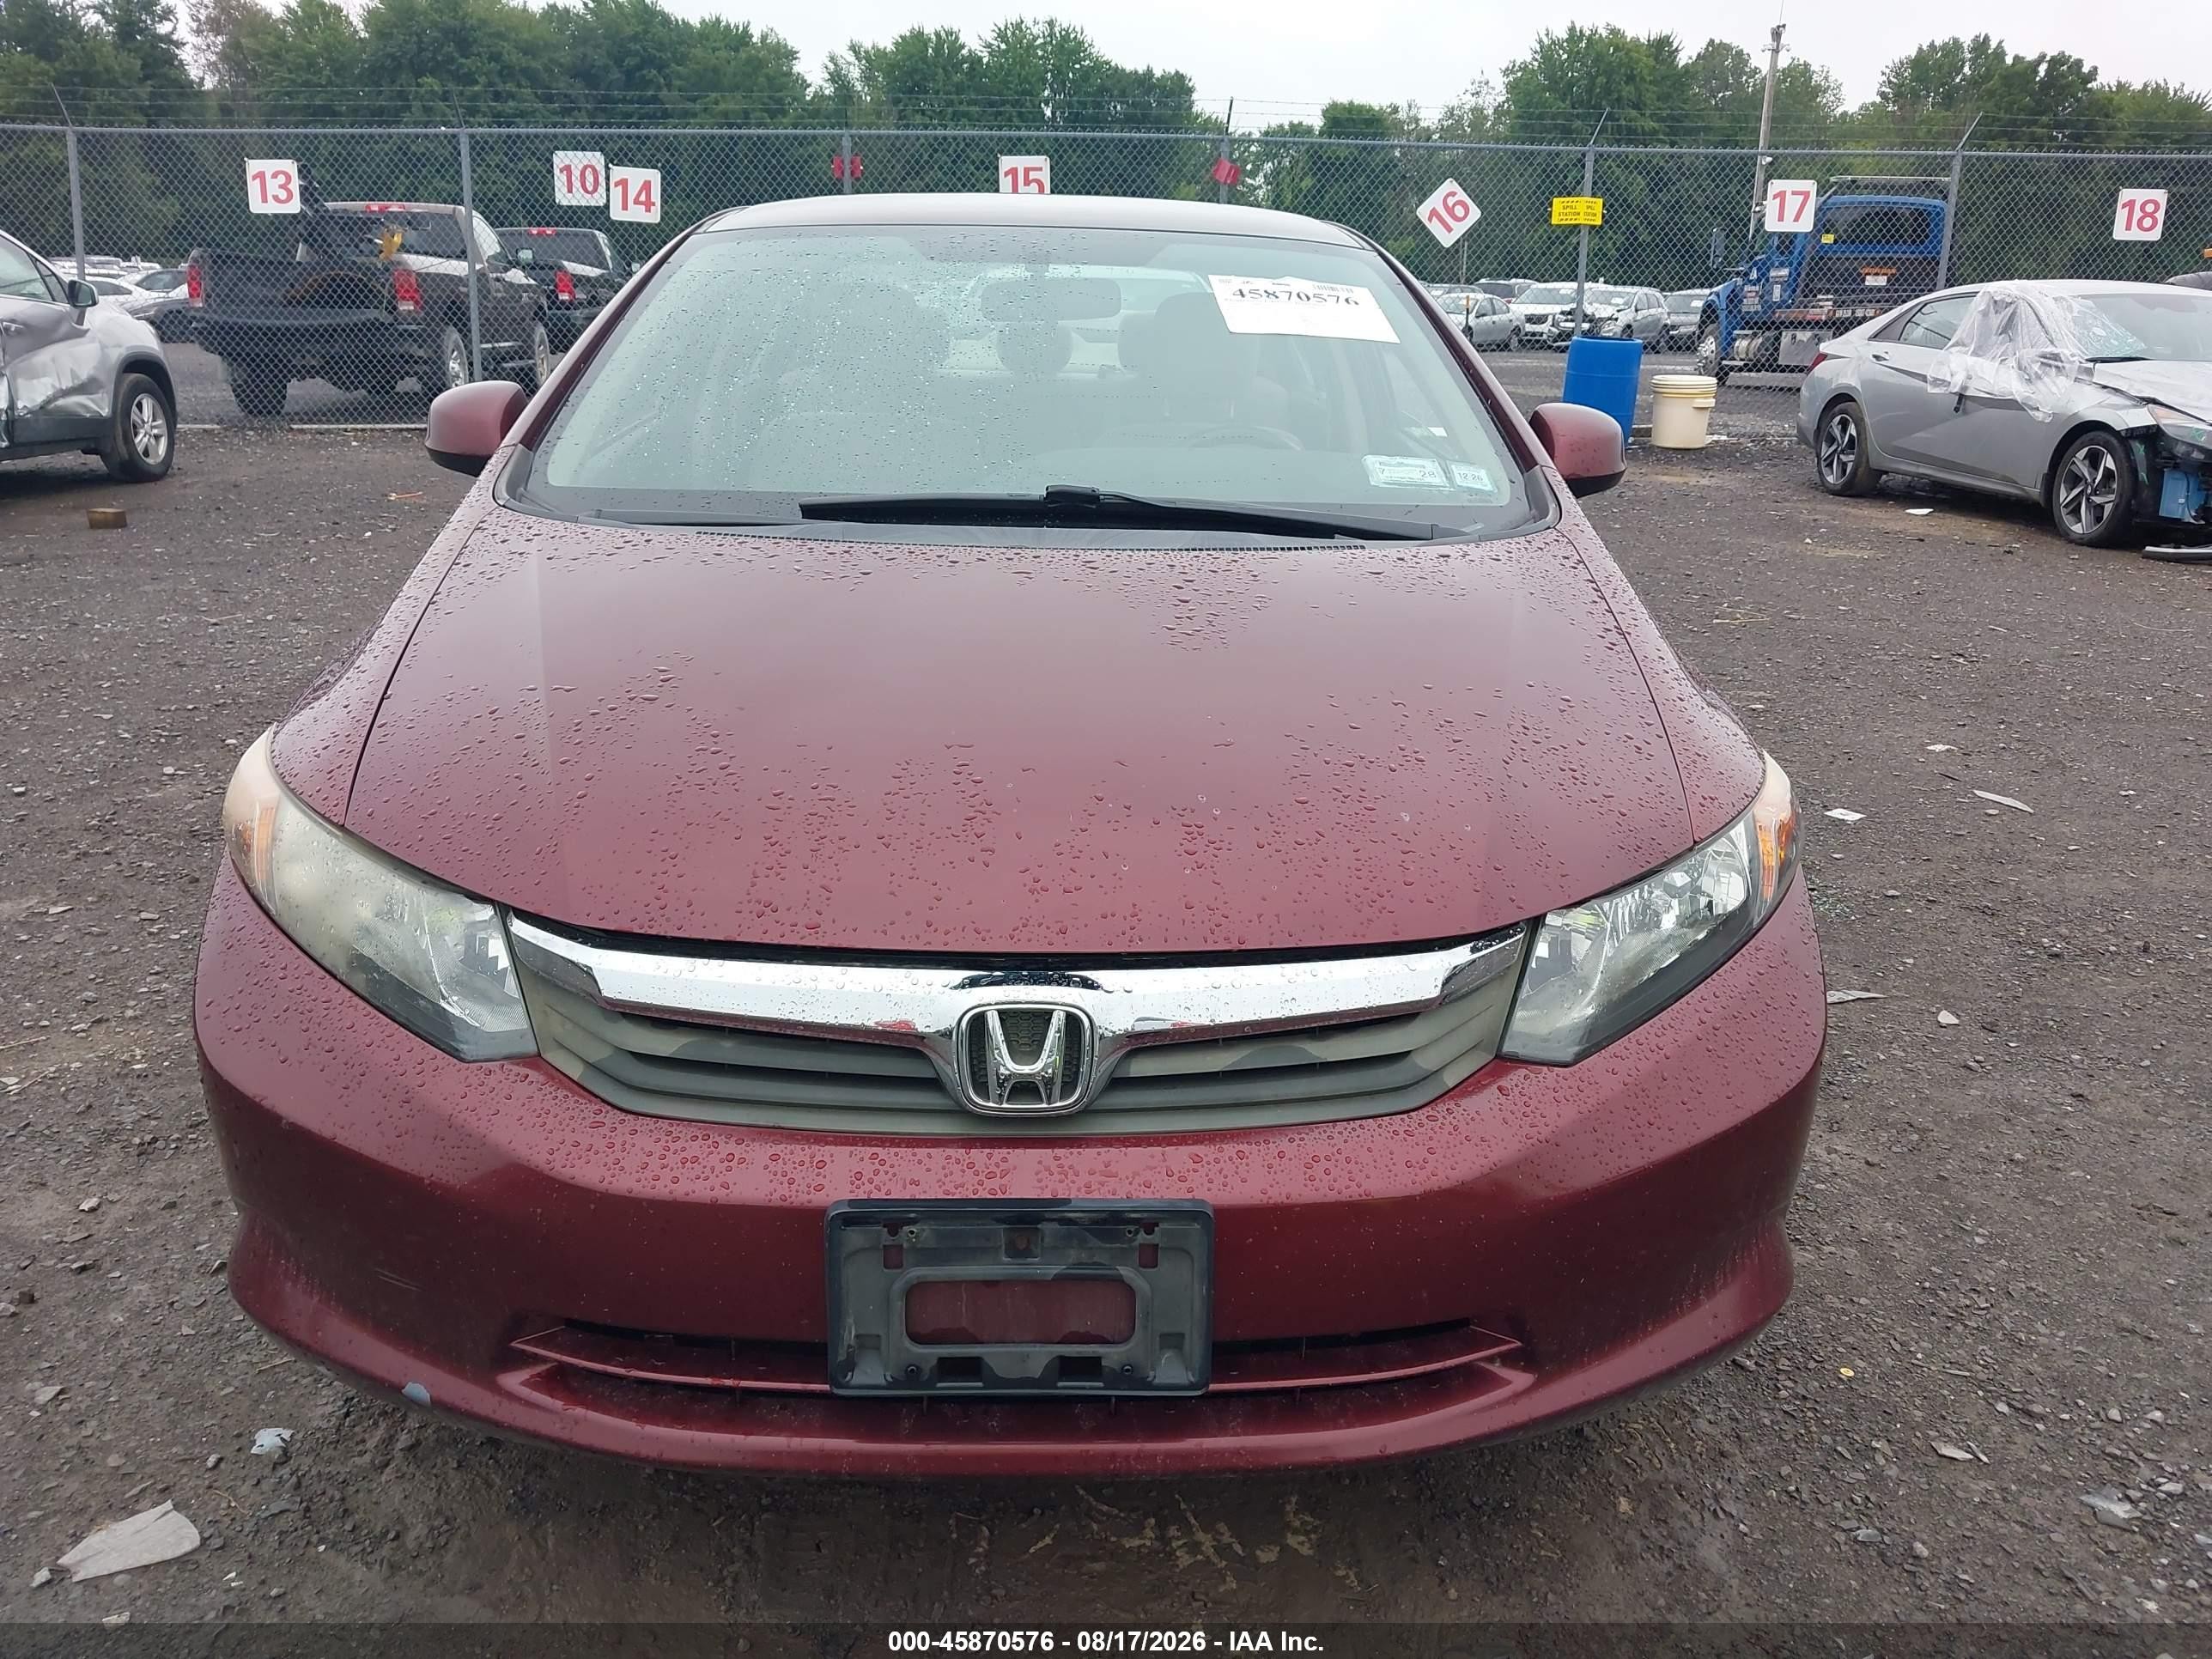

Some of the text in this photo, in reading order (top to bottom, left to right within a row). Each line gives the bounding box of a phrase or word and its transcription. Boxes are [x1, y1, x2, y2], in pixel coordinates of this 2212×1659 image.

[252, 170, 293, 204] 13
[559, 163, 599, 195] 10
[614, 178, 656, 213] 14
[1004, 167, 1045, 193] 15
[1427, 191, 1470, 234] 16
[1772, 189, 1811, 222] 17
[2121, 198, 2161, 232] 18
[1232, 288, 1360, 306] 45870576
[1419, 470, 1437, 478] 28
